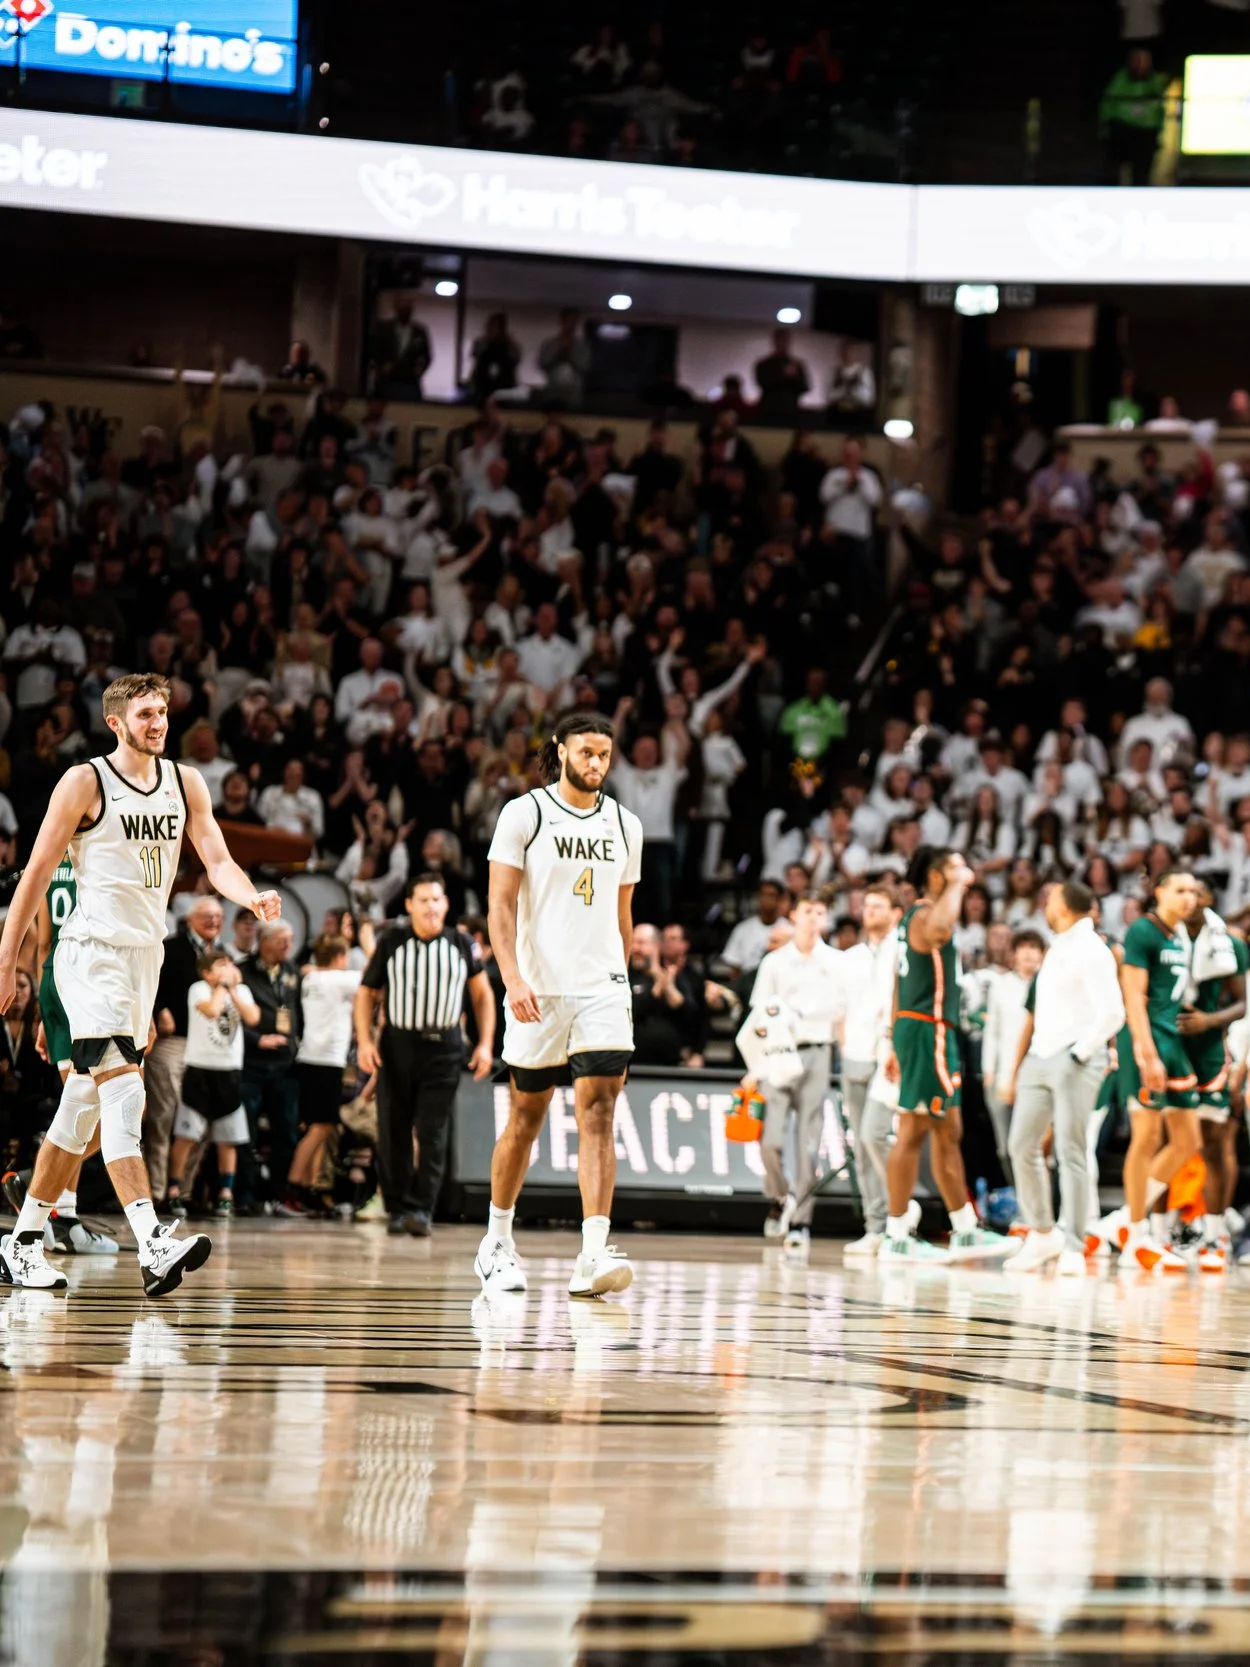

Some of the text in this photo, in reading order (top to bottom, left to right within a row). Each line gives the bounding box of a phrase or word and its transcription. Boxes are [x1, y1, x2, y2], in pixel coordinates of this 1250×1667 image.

[55, 12, 283, 75] Domino's
[461, 173, 801, 249] Harris Teeter
[120, 814, 179, 840] WAKE
[140, 846, 161, 888] 11
[554, 835, 614, 861] WAKE
[573, 867, 593, 905] 4
